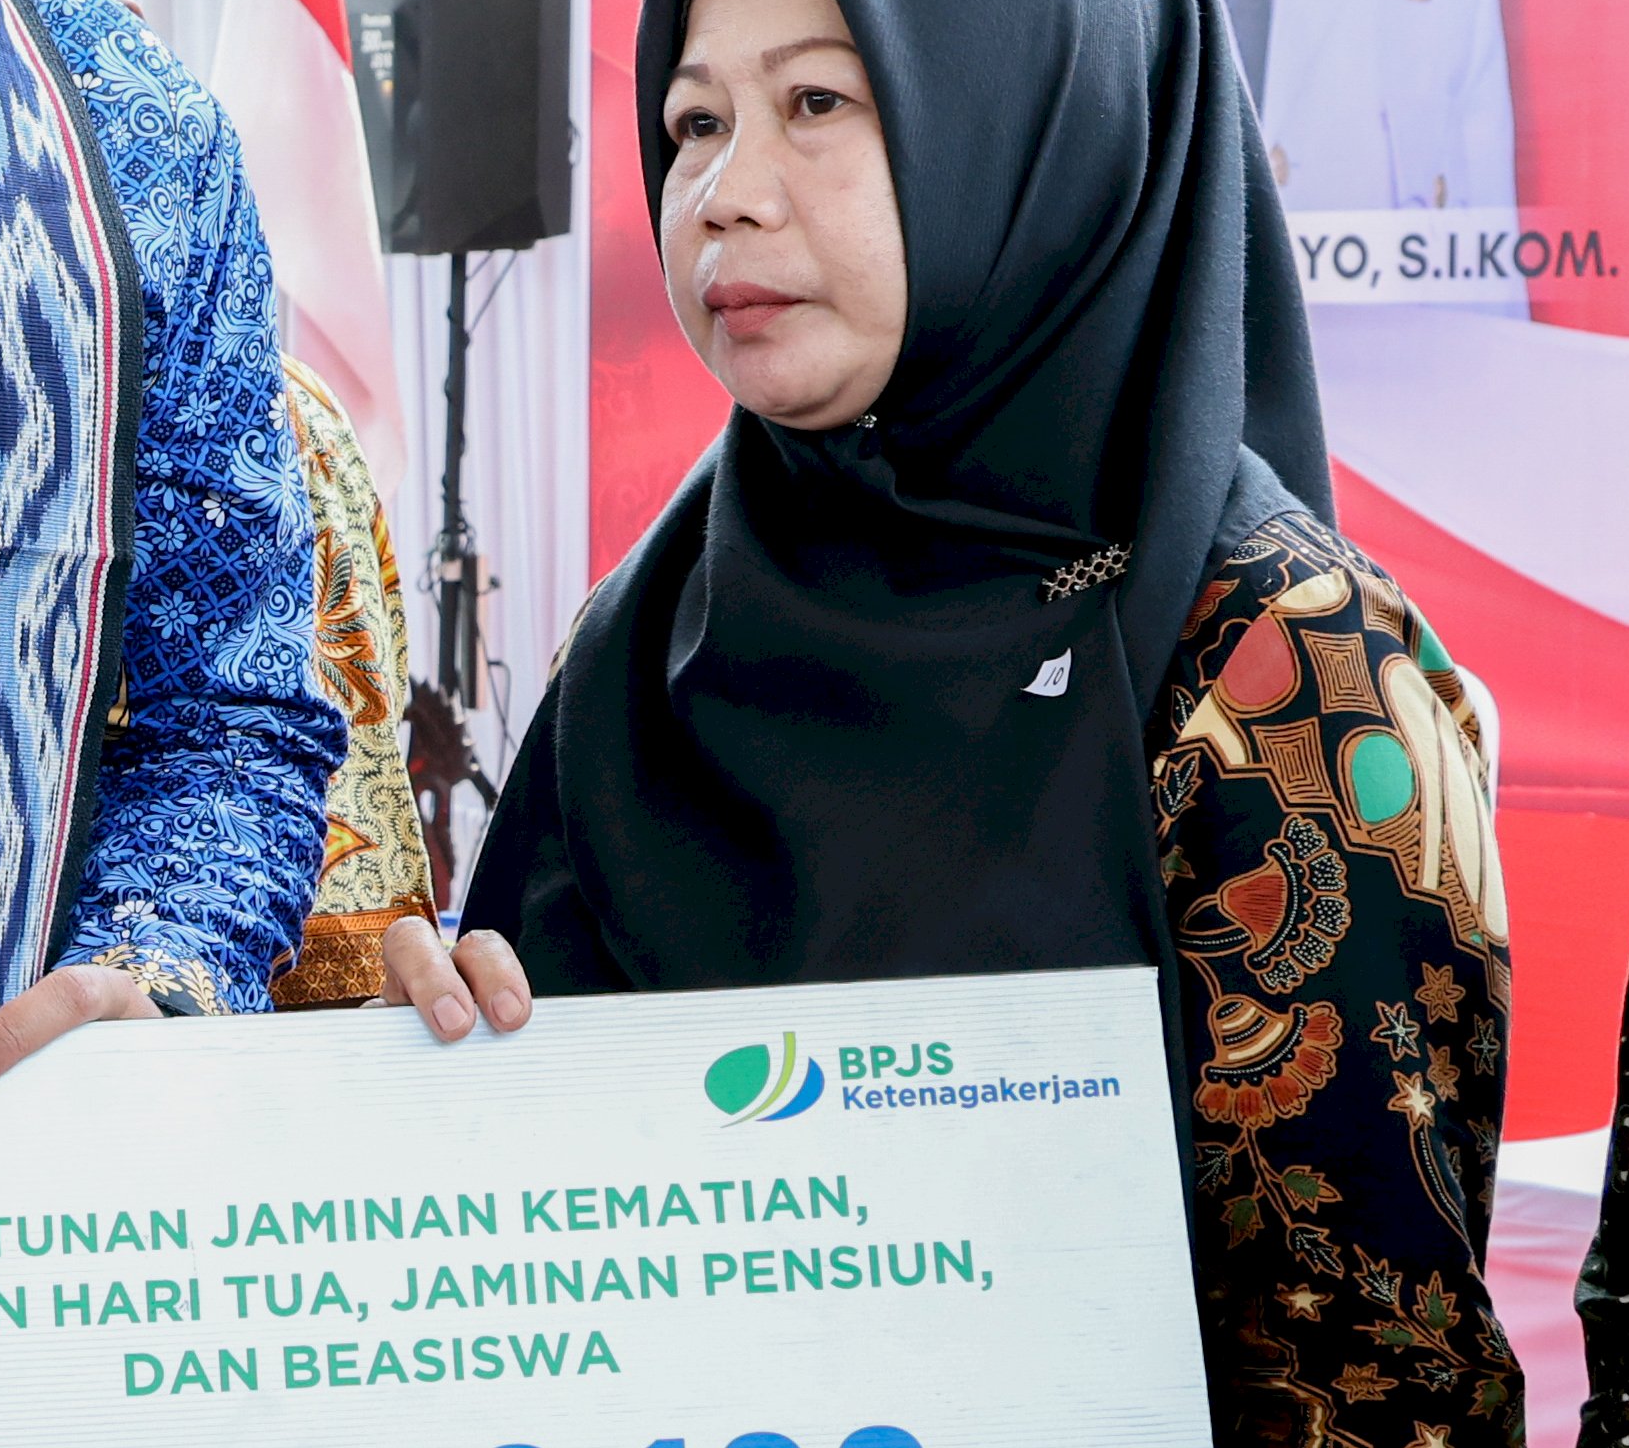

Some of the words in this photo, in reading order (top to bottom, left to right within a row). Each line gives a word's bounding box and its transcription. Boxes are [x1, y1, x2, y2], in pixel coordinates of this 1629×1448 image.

[1399, 230, 1619, 280] S.I.KOM.
[1043, 666, 1065, 687] 10
[839, 1041, 954, 1080] BPJS
[842, 1075, 1120, 1111] Ketenagakerjaan
[211, 1192, 497, 1248] JAMINAN
[522, 1175, 868, 1234] KEMATIAN,
[53, 1278, 201, 1327] HARI
[223, 1272, 369, 1322] TUA,
[391, 1255, 679, 1312] JAMINAN
[703, 1240, 993, 1296] PENSIUN,
[124, 1347, 258, 1397] DAN
[283, 1330, 621, 1389] BEASISWA
